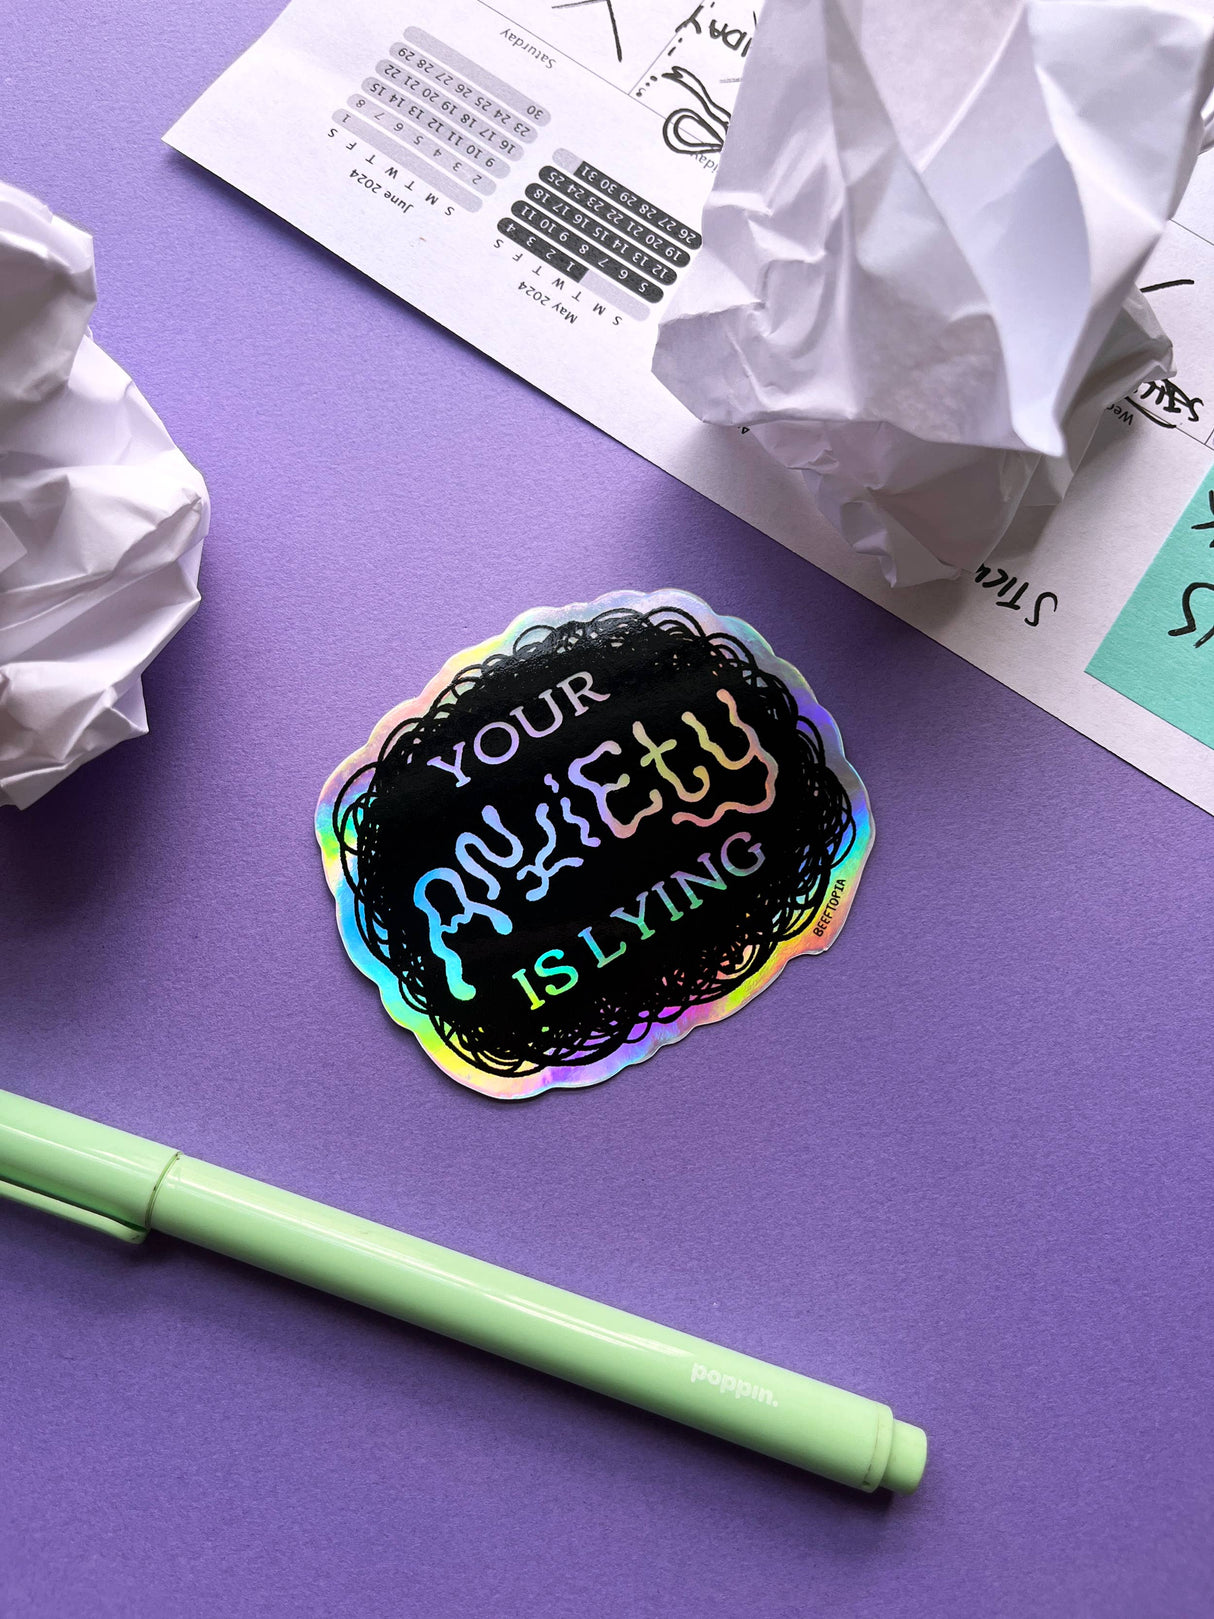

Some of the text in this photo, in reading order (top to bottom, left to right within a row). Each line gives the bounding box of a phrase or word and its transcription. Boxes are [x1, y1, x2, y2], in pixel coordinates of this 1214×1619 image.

[500, 28, 556, 68] Saturday
[342, 114, 351, 123] 1
[369, 82, 495, 168] 9 10 11 12 13 14 15
[384, 64, 516, 155] 16 17 18 19 20 21 22
[398, 46, 530, 137] 23 24 25 26 27 28 29
[527, 106, 543, 120] 30
[328, 128, 455, 216] S M T W T F S
[356, 99, 482, 184] 2 3 4 5 6 7 8
[349, 169, 414, 213] June 2024
[534, 188, 668, 279] 12 13 14 15 16 17 18
[548, 171, 682, 261] 19 20 21 22 23 24 25
[581, 166, 696, 243] 26 27 28 29 30 31
[493, 239, 622, 326] S M T W T F S
[505, 223, 575, 272] 1 2 3 4
[520, 206, 648, 292] 5 6 7 8 9 10 11
[517, 281, 577, 324] May 2024
[427, 670, 610, 788] YOUR
[511, 831, 767, 1011] IS LYING
[812, 879, 847, 937] BEEFTOPIA
[690, 1362, 778, 1408] poppin.
